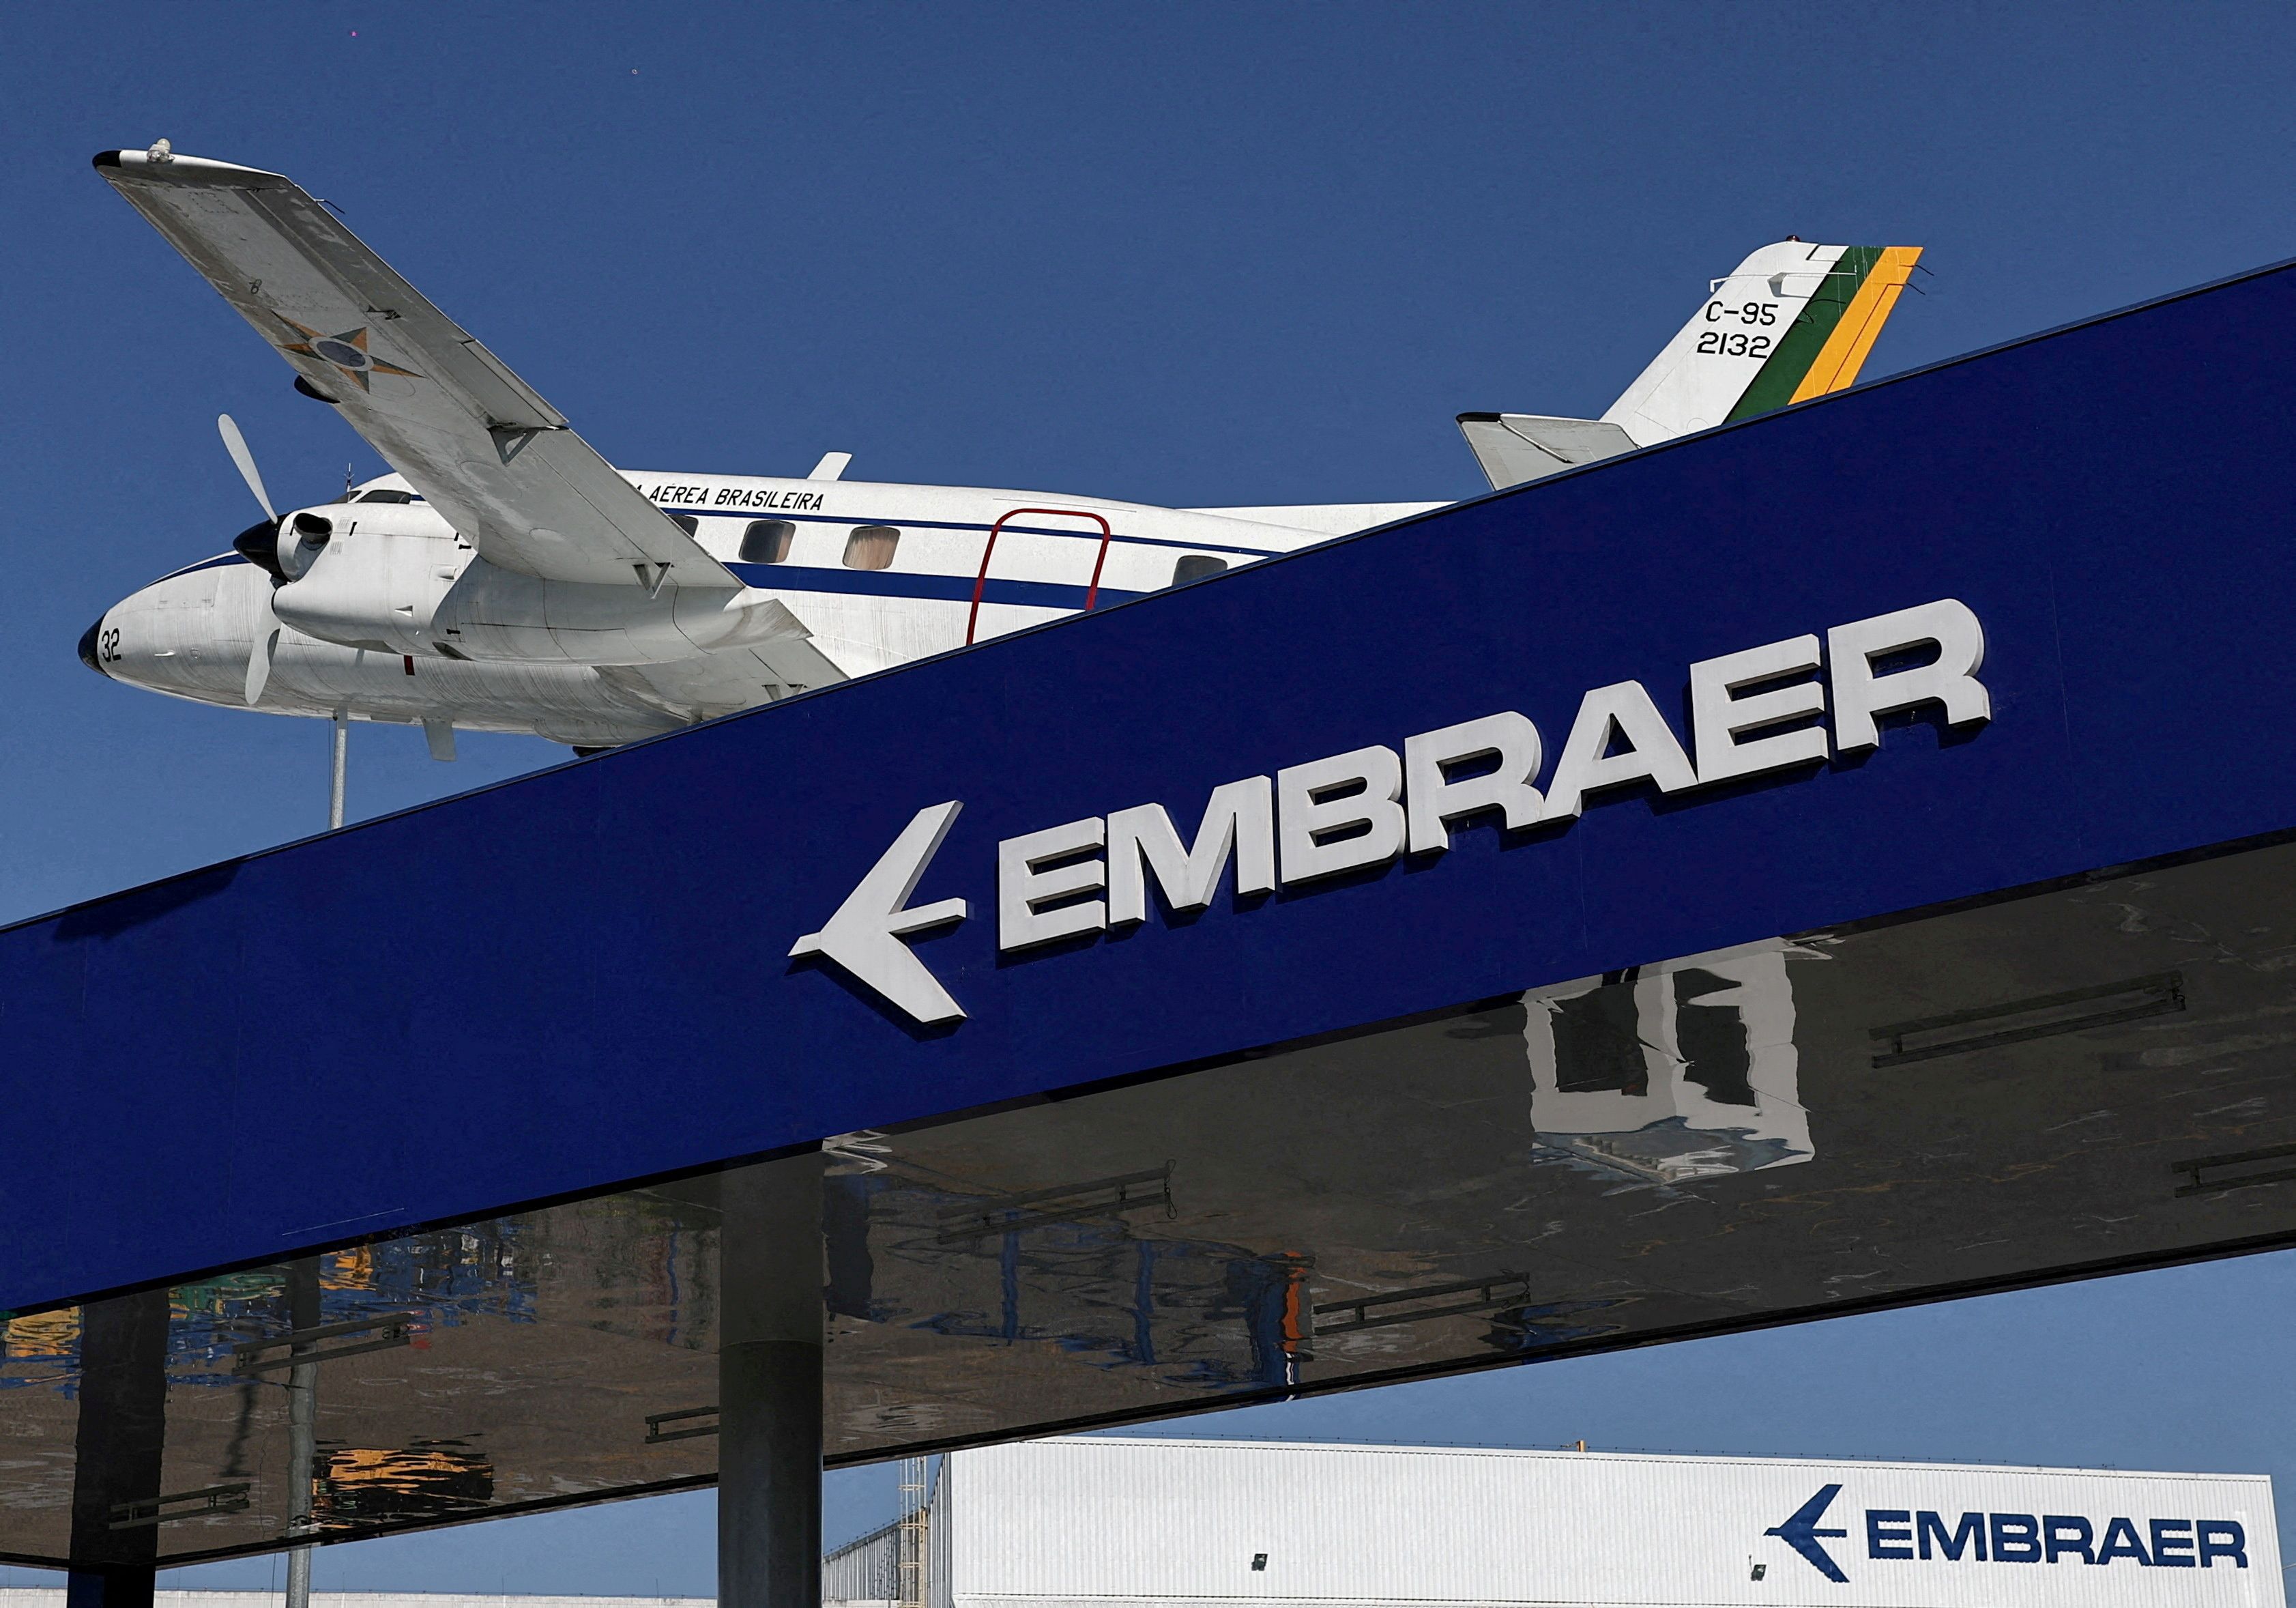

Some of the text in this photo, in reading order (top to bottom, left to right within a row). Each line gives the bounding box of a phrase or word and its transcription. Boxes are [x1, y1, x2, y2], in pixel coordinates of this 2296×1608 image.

[1705, 300, 1779, 326] C-95
[1696, 331, 1771, 359] 2132
[714, 488, 825, 511] BRASILEIRA
[101, 627, 122, 663] 32
[998, 598, 1992, 952] EMBRAER
[1865, 1509, 2248, 1568] EMBRAER
